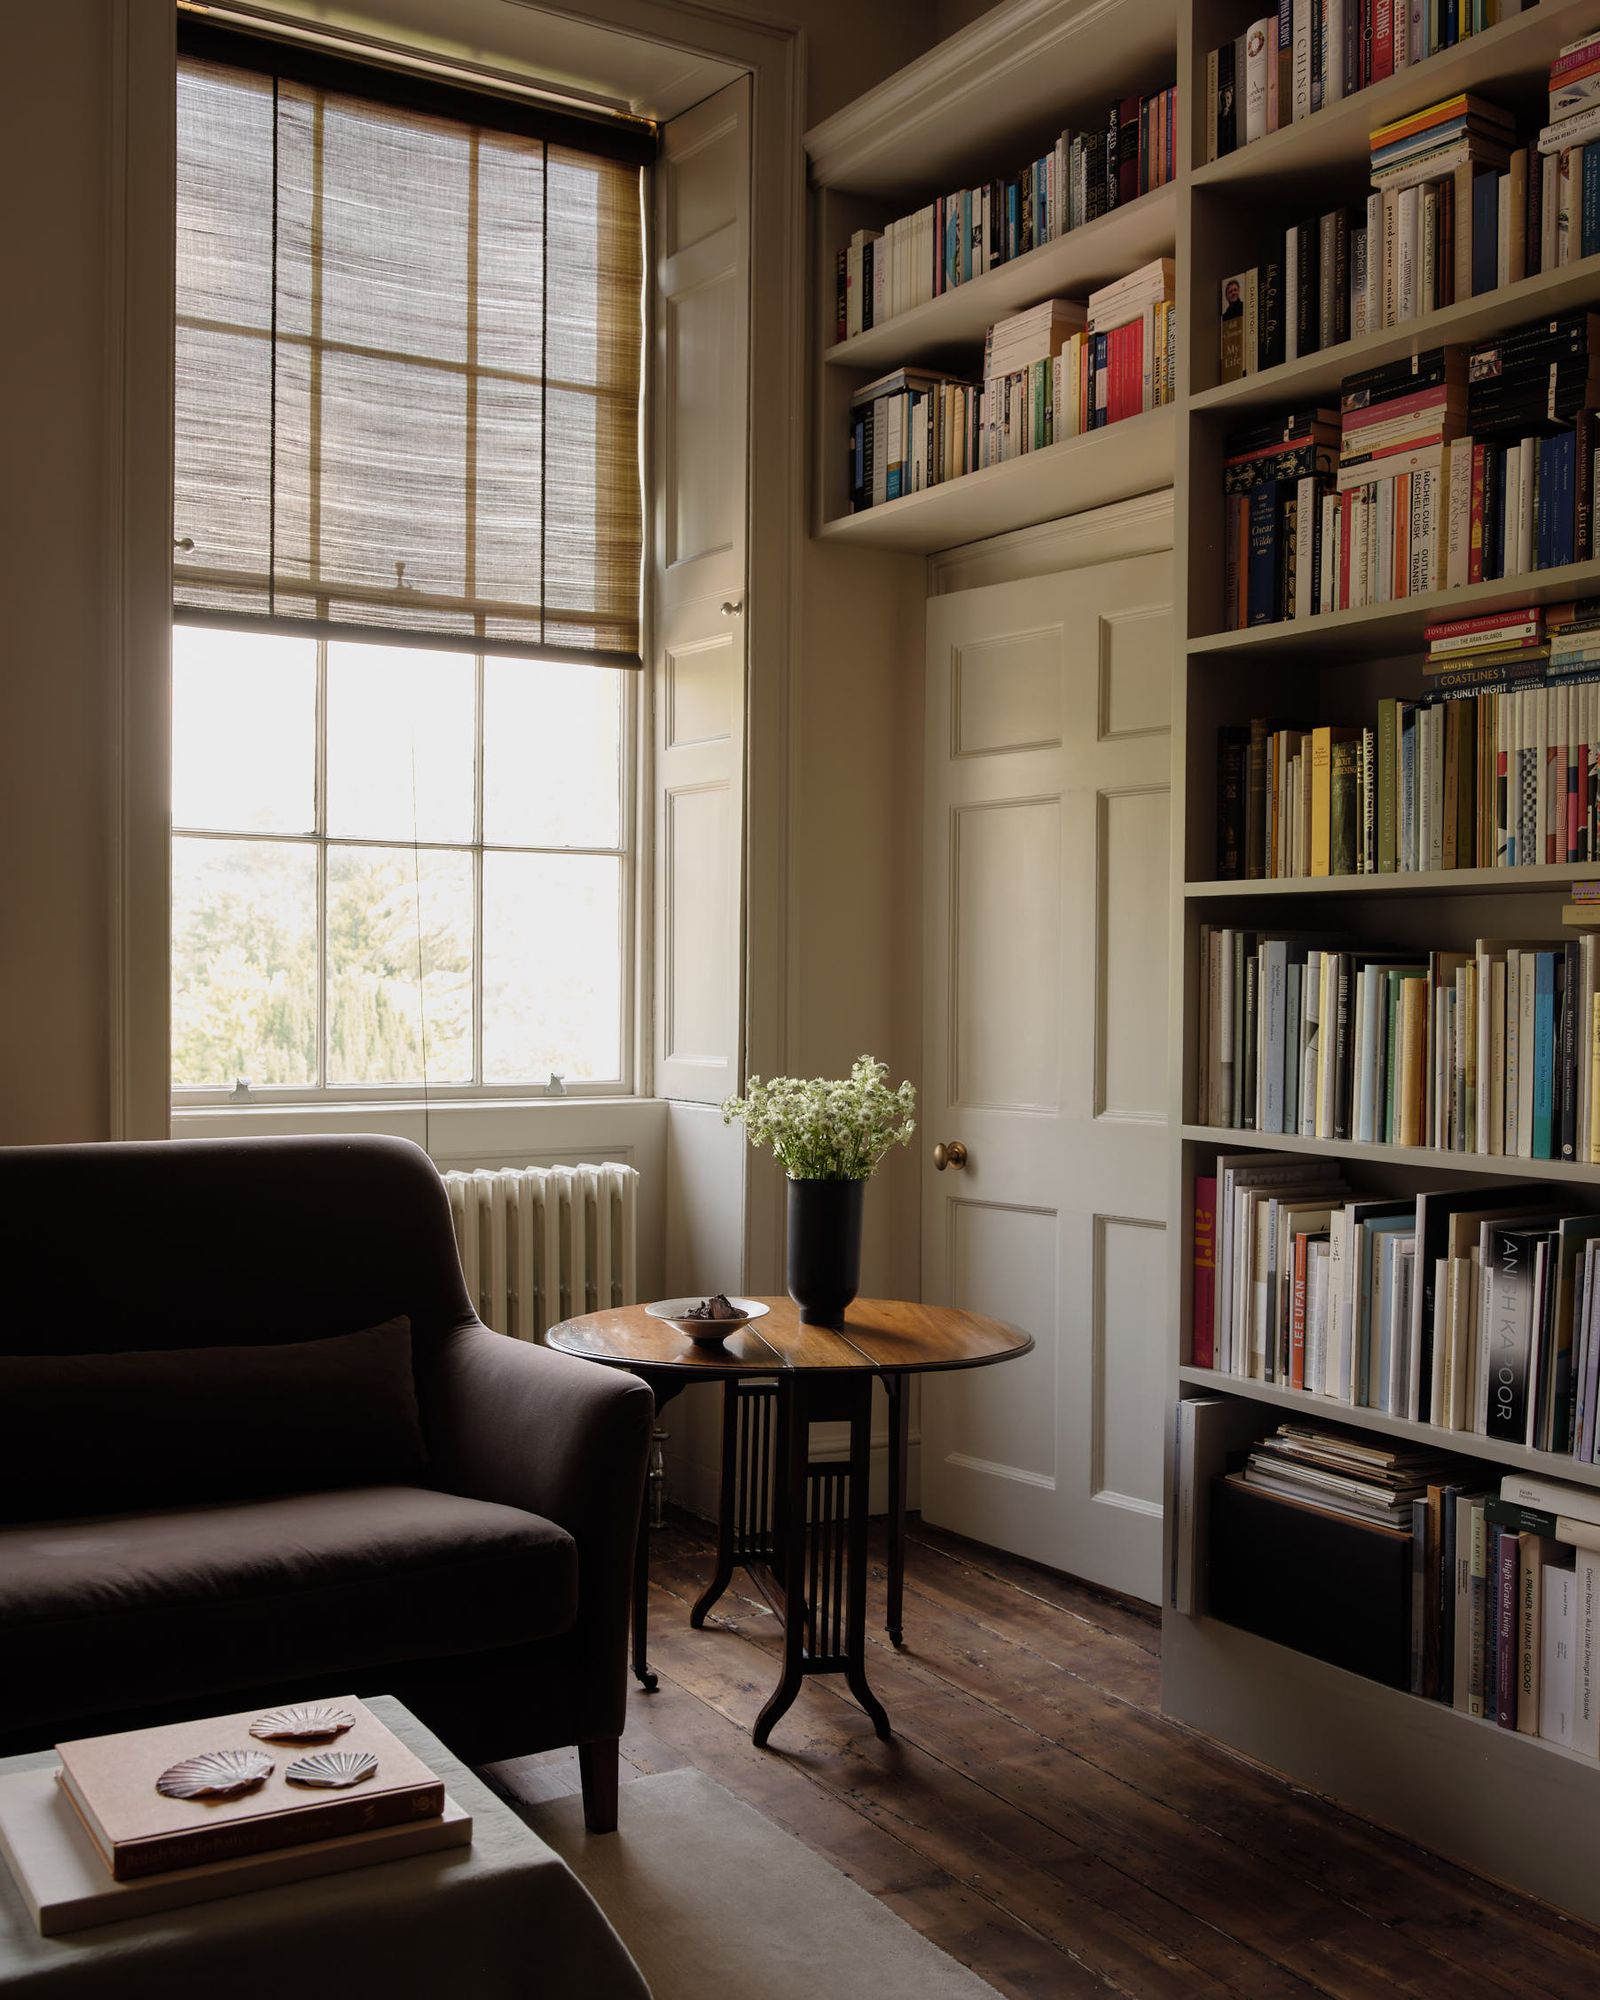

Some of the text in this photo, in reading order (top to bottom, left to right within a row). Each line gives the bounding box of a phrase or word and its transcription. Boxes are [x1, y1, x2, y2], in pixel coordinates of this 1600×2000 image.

[1296, 37, 1307, 105] CHING
[1108, 173, 1117, 208] ATWOOD
[1357, 233, 1368, 272] Stephen
[1386, 205, 1396, 327] period power maisie hill
[1356, 273, 1367, 292] Fry
[1224, 358, 1242, 371] Life
[1225, 344, 1240, 360] My
[1579, 441, 1588, 492] McINERNEY
[1460, 453, 1470, 516] SOME SORT
[1298, 488, 1308, 560] McINERNEY
[1449, 464, 1460, 553] EPIC GRANDEUR
[1578, 502, 1588, 547] JUICE
[1252, 524, 1274, 536] Oscar
[1252, 535, 1274, 547] Wilde
[1314, 532, 1322, 554] SCOTT
[1412, 473, 1422, 593] RACHEL CUSK TRANSIT
[1420, 470, 1431, 591] RACHEL CUSK OUTLINE
[1314, 554, 1322, 598] FITZGERALD
[1359, 550, 1367, 585] BOTTON
[1427, 626, 1445, 640] TOVE
[1444, 622, 1470, 636] JANSSON
[1459, 631, 1503, 649] THE ARAN ISLANDS
[1440, 667, 1499, 686] COASTLINES
[1452, 686, 1479, 699] SUNLIT
[1480, 682, 1508, 695] NIGHT
[1511, 683, 1545, 693] DINERSTEIN
[1514, 677, 1540, 685] REBECCA
[1555, 679, 1576, 688] Decca
[1364, 731, 1374, 832] BOOK COLLECTING
[1384, 798, 1392, 844] COUNTRY
[1338, 975, 1348, 1024] DONALD JUDD
[1294, 1279, 1306, 1348] LEE UFAN
[1496, 1238, 1519, 1421] ANISH KAPOOR
[1504, 1557, 1512, 1581] High
[1503, 1582, 1511, 1610] Grade
[1501, 1610, 1511, 1638] Living
[1523, 1568, 1533, 1695] A PRIMER IN LUNAR GEOLOGY
[1584, 1628, 1592, 1648] Little
[1585, 1617, 1592, 1627] As
[1471, 1631, 1479, 1688] GEOGRAPHIC
[1583, 1648, 1591, 1678] Design
[1582, 1687, 1590, 1721] Possible
